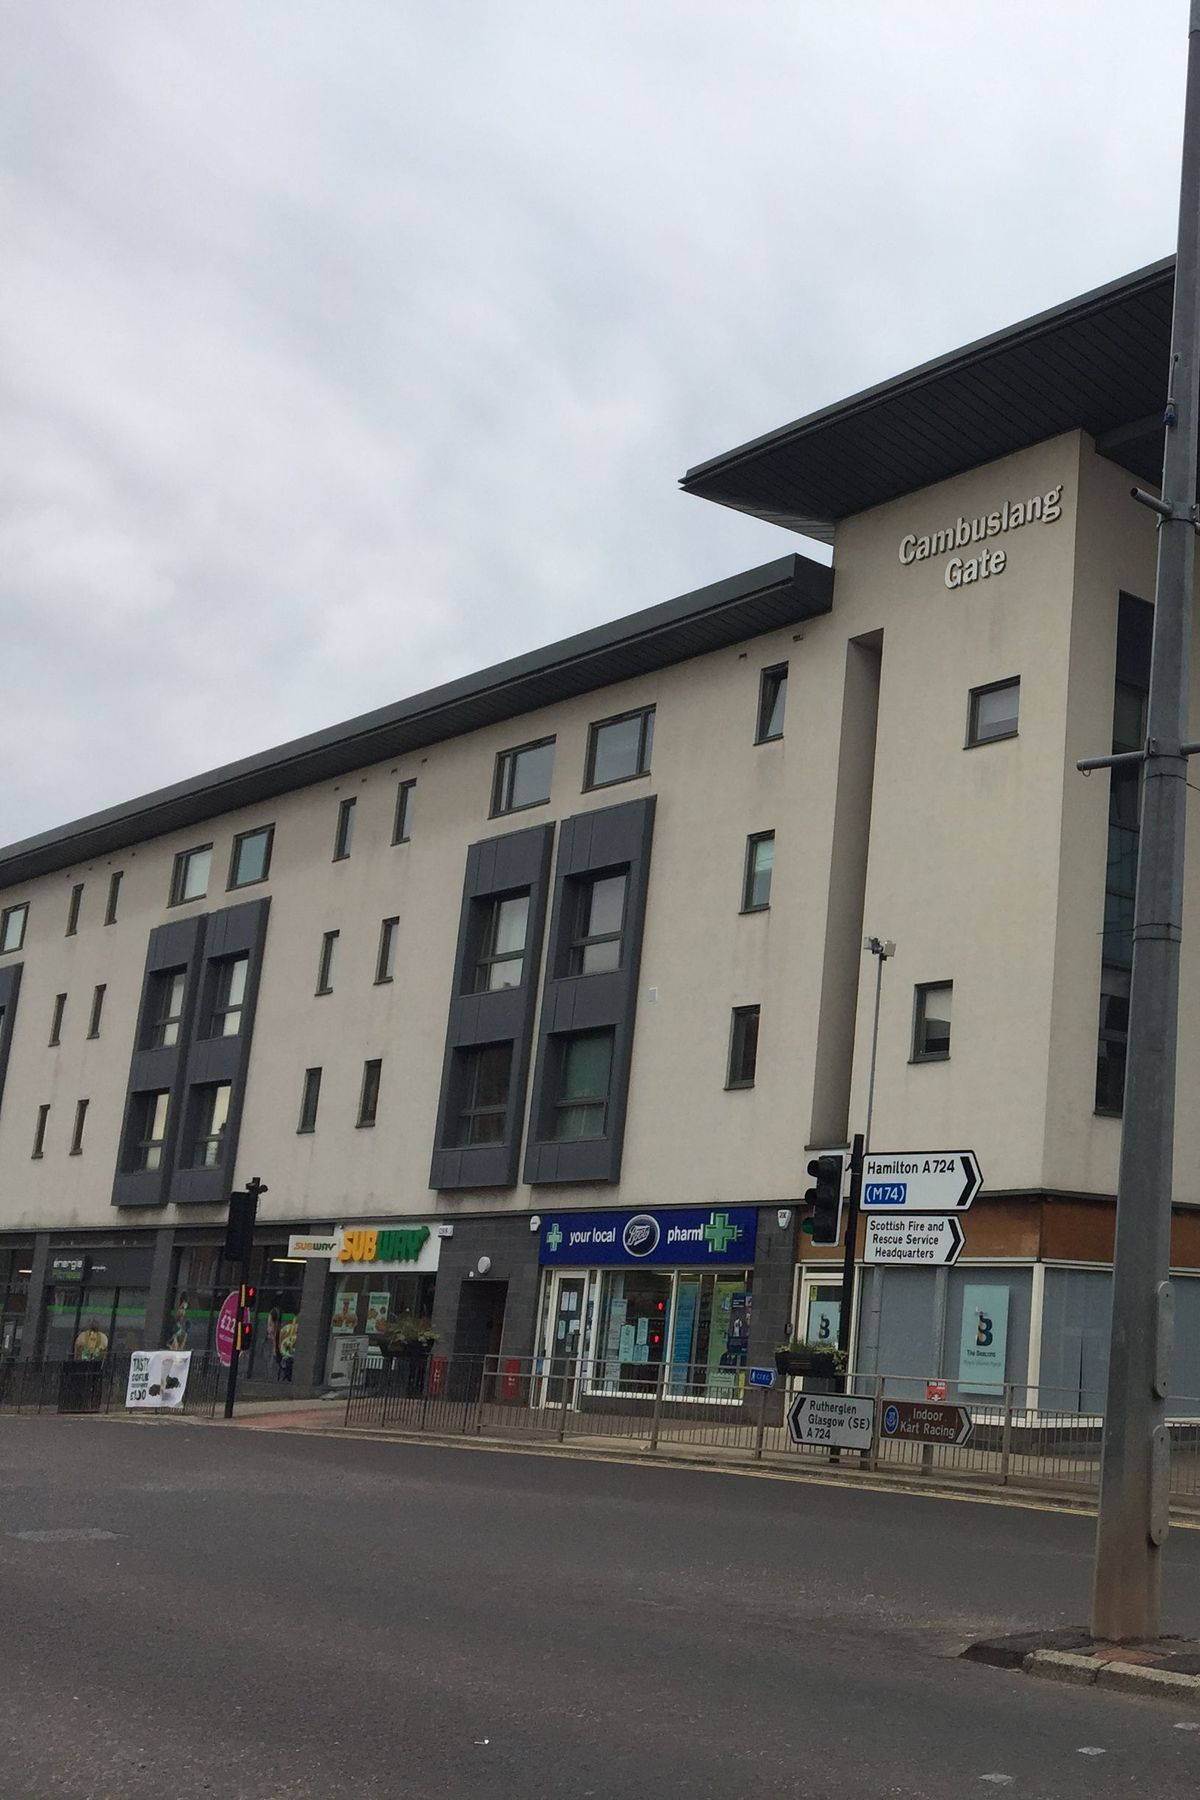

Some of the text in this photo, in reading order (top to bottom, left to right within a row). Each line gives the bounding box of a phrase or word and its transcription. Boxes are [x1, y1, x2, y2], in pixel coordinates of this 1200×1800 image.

[899, 485, 1063, 565] Cambuslang
[944, 548, 1006, 589] Gate
[867, 1160, 918, 1174] Hamilton
[866, 1185, 905, 1202] (M74)
[870, 1220, 944, 1231] Scottish Fire and
[569, 1229, 590, 1246] your
[592, 1227, 616, 1242] local
[627, 1225, 650, 1246] Boots
[873, 1234, 939, 1245] Rescue Service
[294, 1241, 336, 1251] SUBWAY
[338, 1226, 431, 1263] SUBWAY
[875, 1247, 934, 1259] Headquarters
[809, 1400, 857, 1415] Rutherglen
[913, 1408, 944, 1421] Indoor
[808, 1413, 871, 1431] Glasgow (SE)
[900, 1421, 955, 1439] Kart Racing
